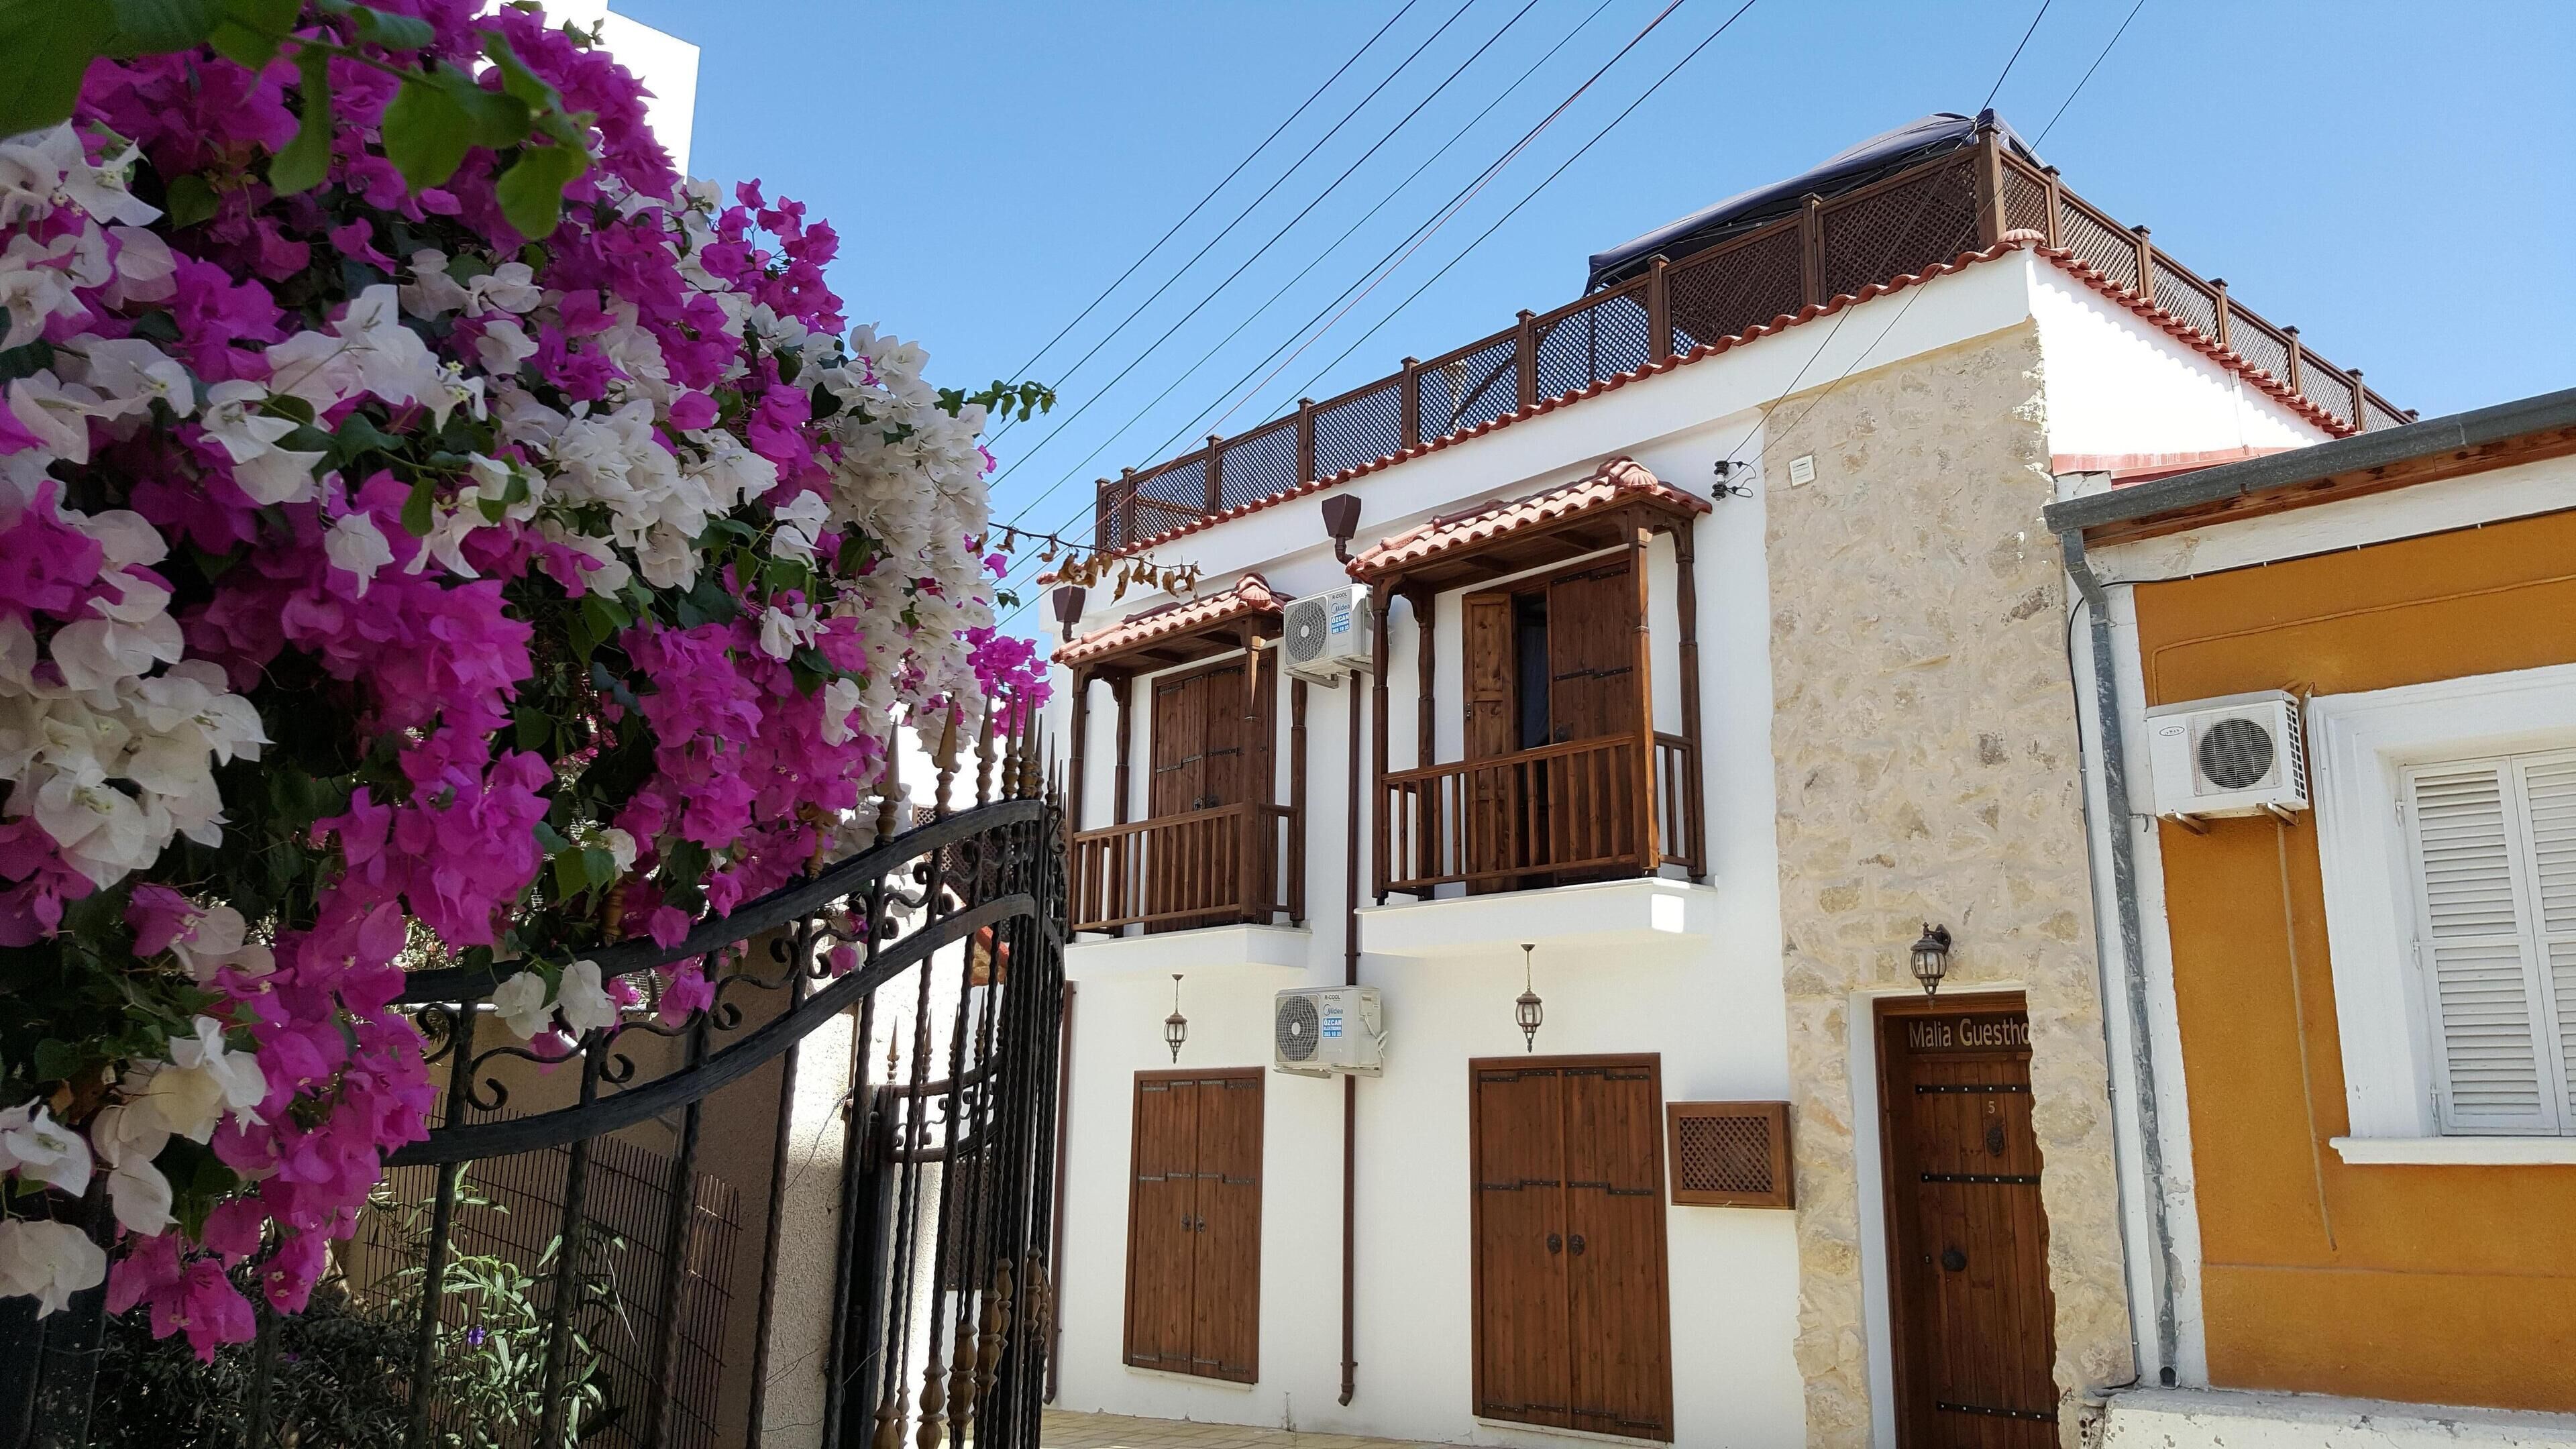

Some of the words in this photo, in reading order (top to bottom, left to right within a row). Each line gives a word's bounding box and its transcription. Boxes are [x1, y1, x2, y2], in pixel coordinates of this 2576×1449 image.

[1331, 602, 1350, 614] Midea
[1323, 1004, 1344, 1016] Midea
[1909, 1020, 1951, 1048] Malia
[1988, 1100, 1996, 1114] 5
